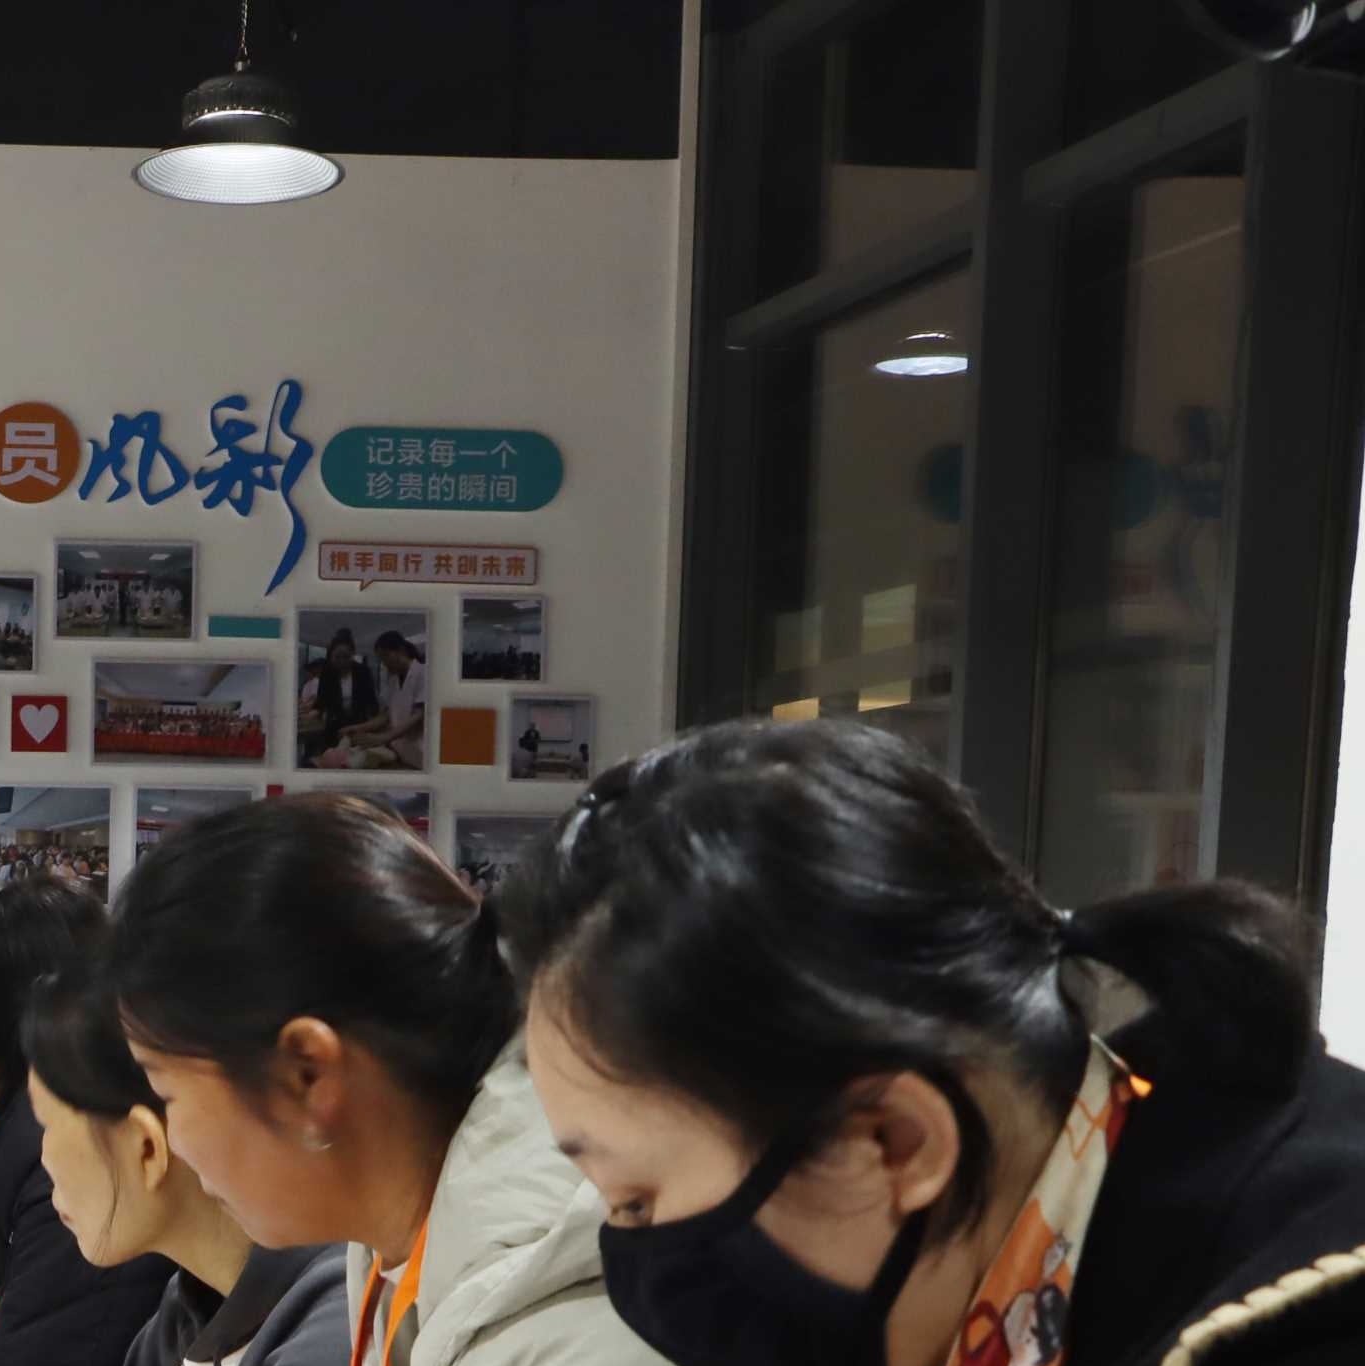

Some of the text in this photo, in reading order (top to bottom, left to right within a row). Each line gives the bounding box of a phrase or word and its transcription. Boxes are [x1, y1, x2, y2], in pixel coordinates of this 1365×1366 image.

[366, 437, 517, 469] 记录每一个
[366, 472, 517, 502] 珍贵的瞬间
[329, 550, 526, 577] 携手同行 共创未来
